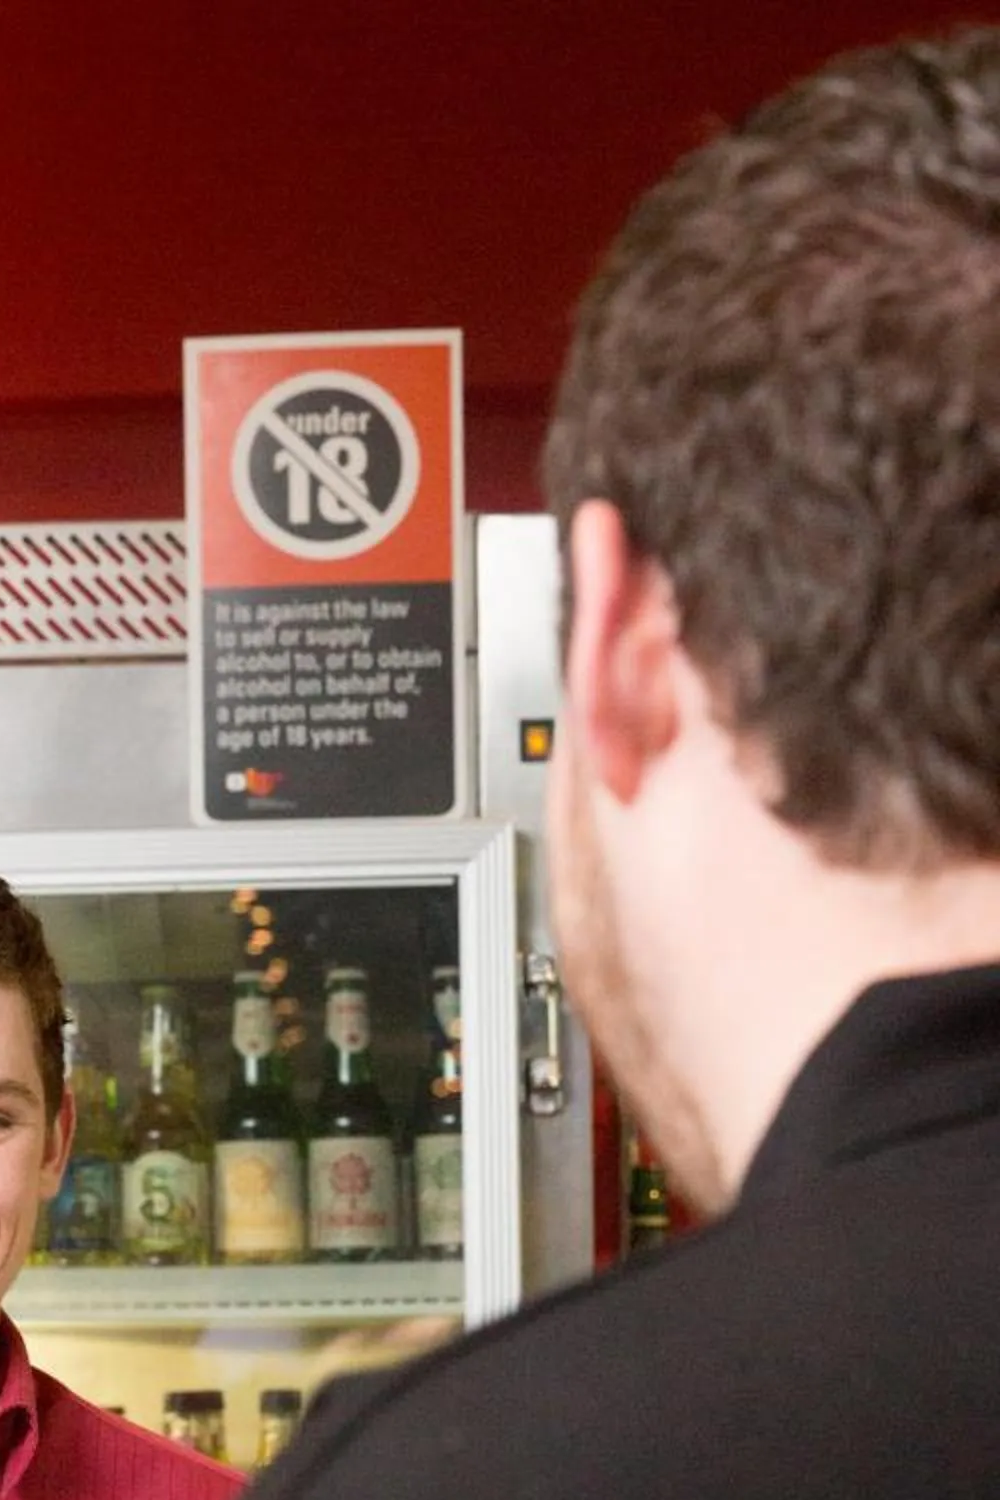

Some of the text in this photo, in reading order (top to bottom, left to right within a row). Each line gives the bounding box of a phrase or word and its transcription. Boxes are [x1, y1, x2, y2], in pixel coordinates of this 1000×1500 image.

[285, 405, 371, 435] under
[273, 435, 369, 525] 18
[216, 597, 411, 627] It is against the law
[215, 626, 374, 649] to sell or supply
[216, 651, 291, 674] alcohol
[325, 652, 347, 670] or
[352, 651, 374, 670] to
[377, 646, 443, 669] obtain
[216, 673, 291, 698] alcohol
[295, 678, 322, 697] on
[325, 672, 391, 695] behalf
[216, 698, 408, 726] a person under the
[216, 724, 373, 752] age of 18 years.
